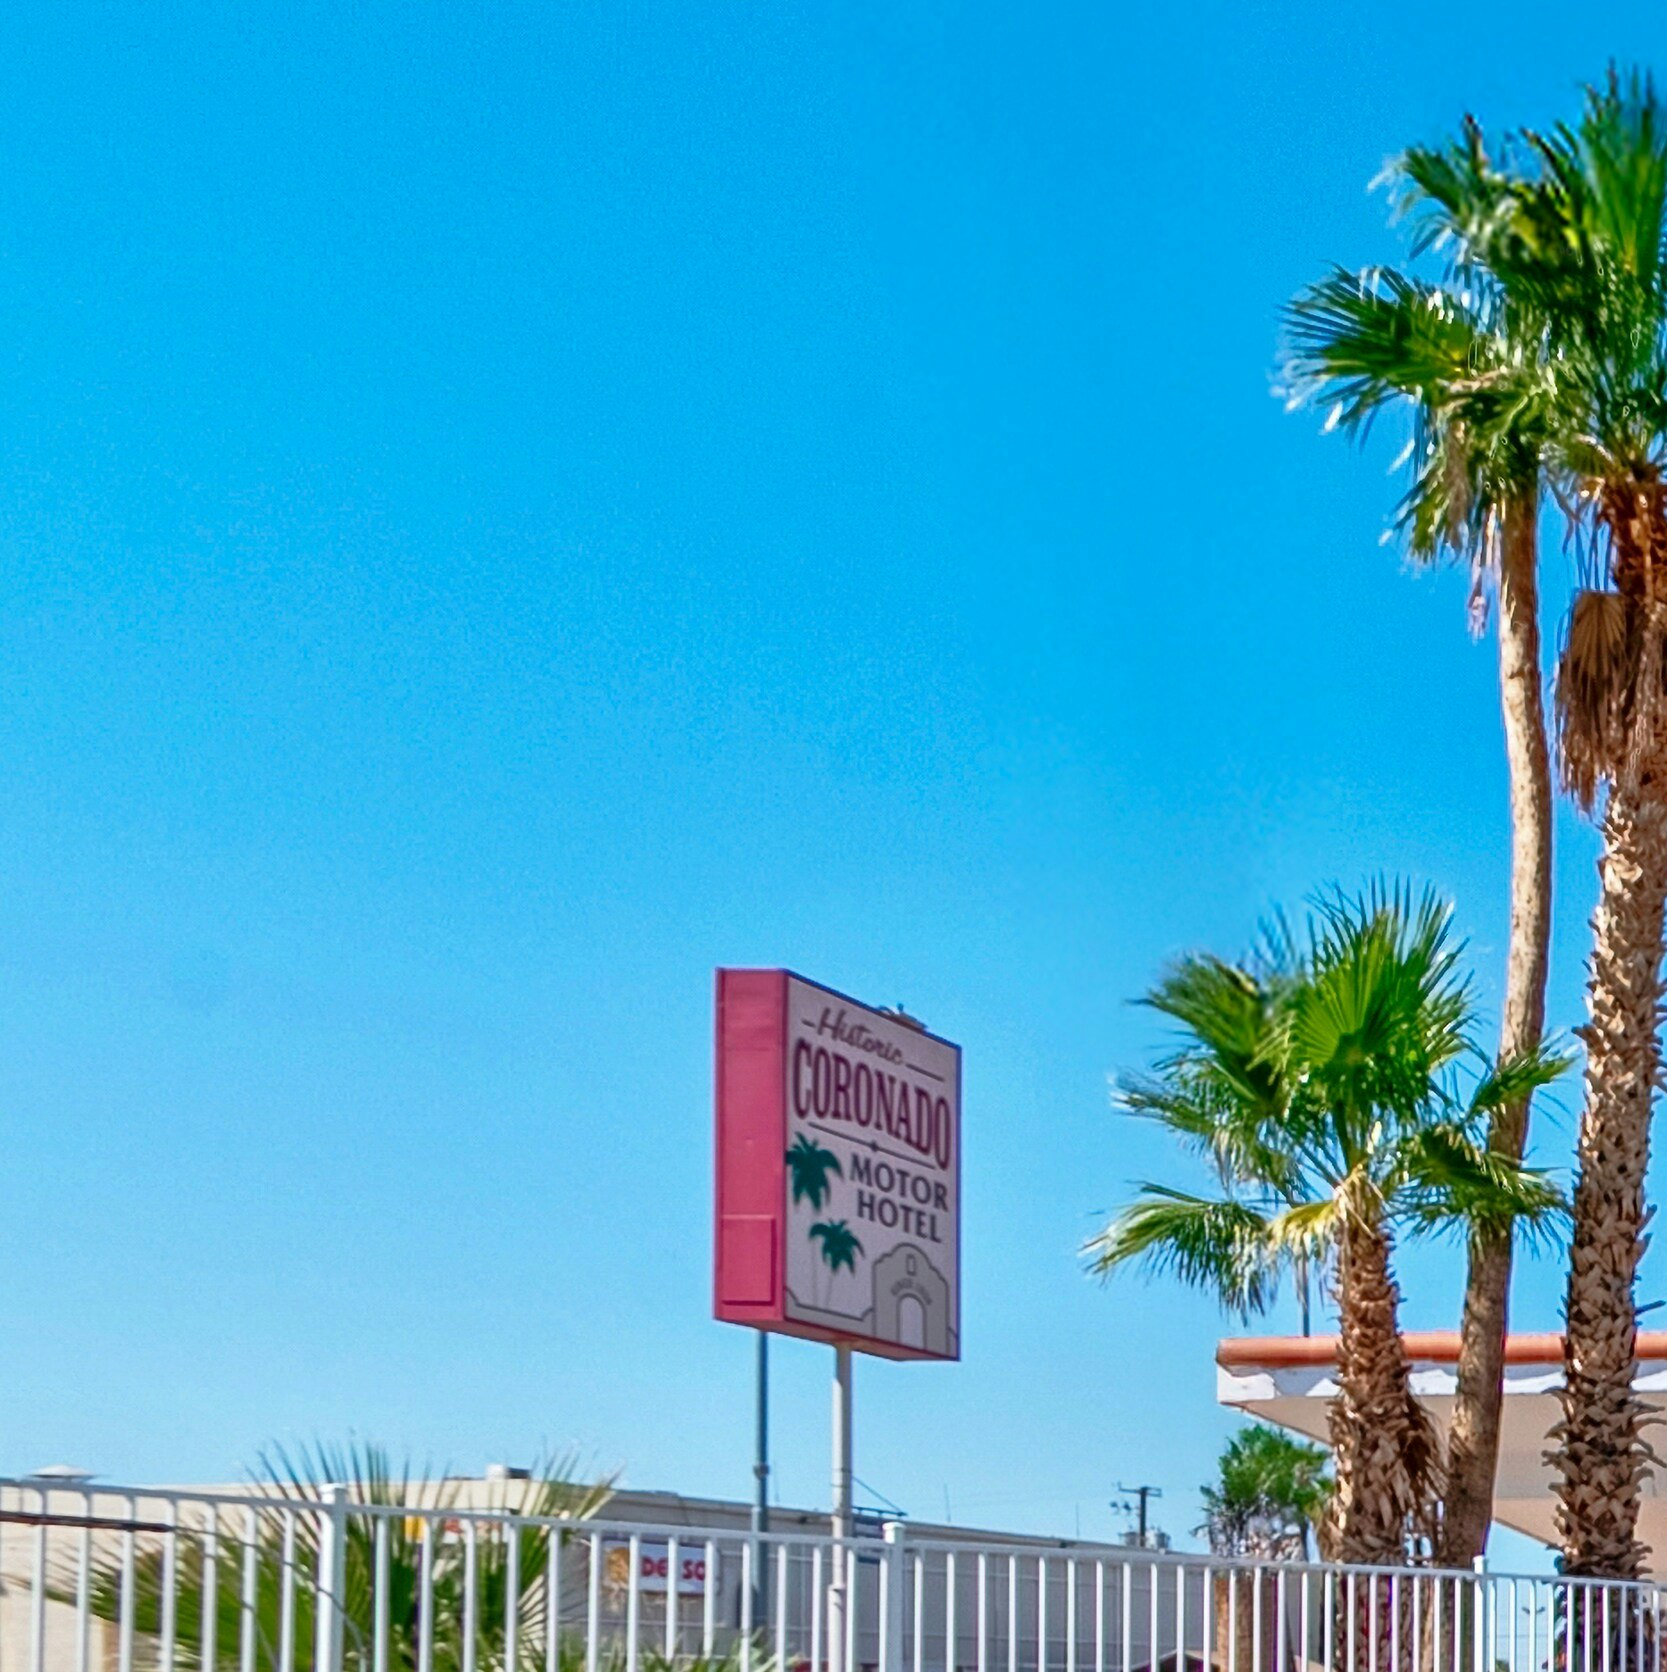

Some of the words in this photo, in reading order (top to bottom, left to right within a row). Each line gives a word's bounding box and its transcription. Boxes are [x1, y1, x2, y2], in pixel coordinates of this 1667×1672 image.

[817, 1006, 904, 1066] Historic
[793, 1038, 950, 1171] CORONADO
[849, 1152, 949, 1213] MOTOR
[857, 1188, 942, 1244] HOTEL
